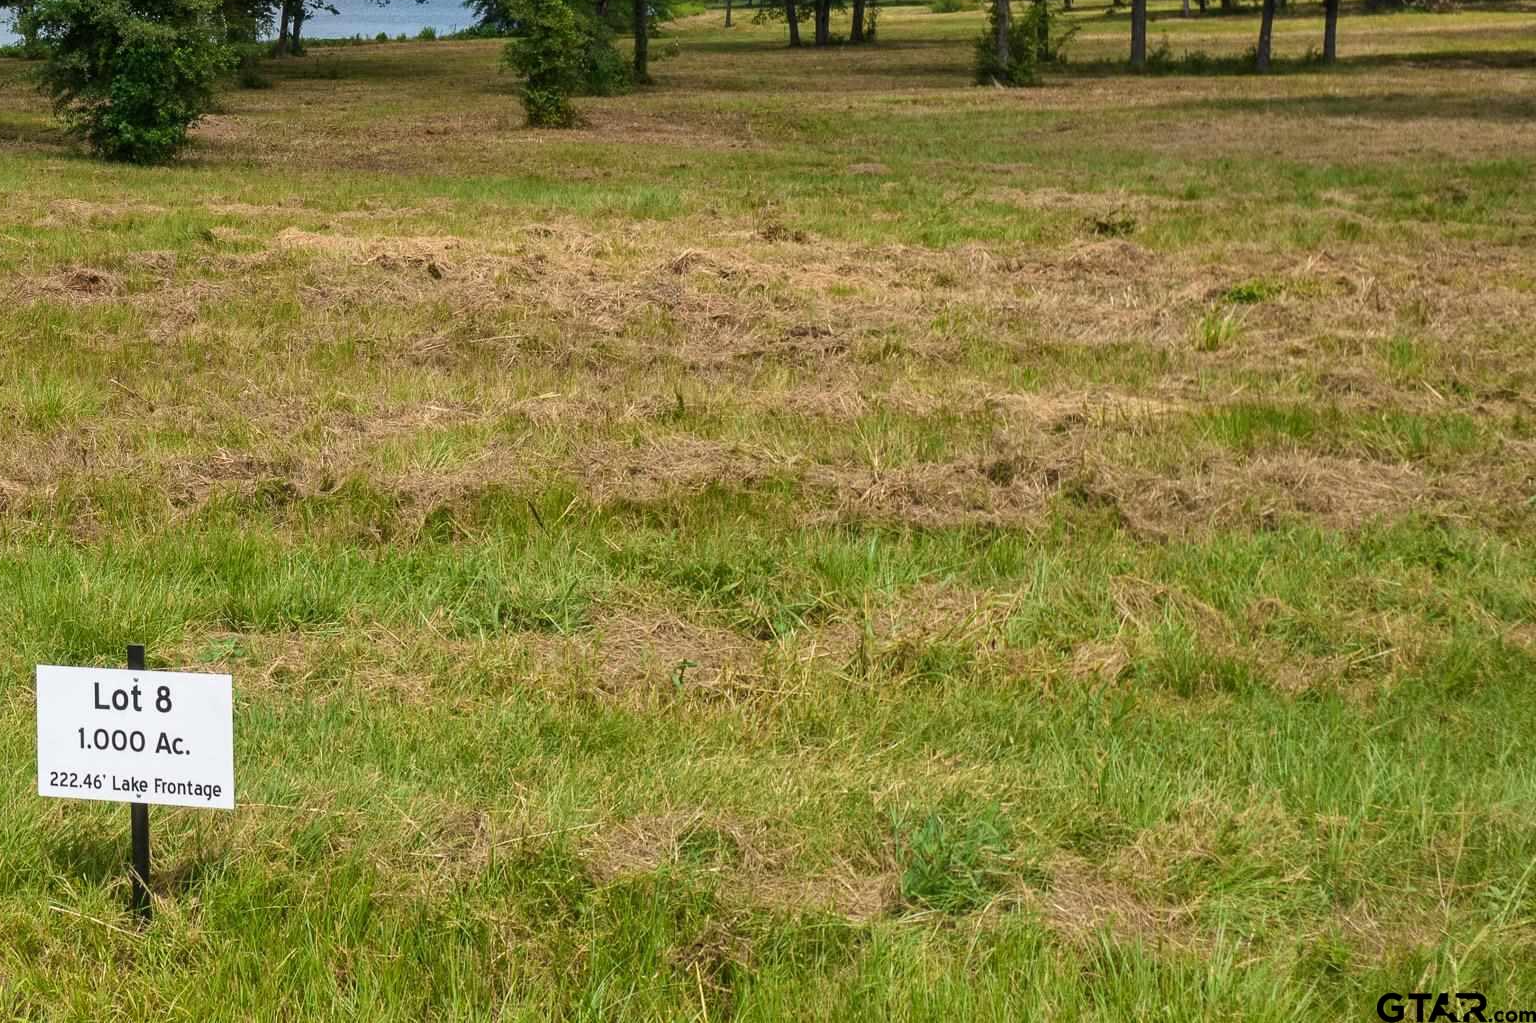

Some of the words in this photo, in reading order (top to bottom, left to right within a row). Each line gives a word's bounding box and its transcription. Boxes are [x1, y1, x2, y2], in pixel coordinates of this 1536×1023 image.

[94, 682, 142, 712] Lot
[155, 685, 173, 713] 8
[78, 727, 145, 752] 1.000
[155, 732, 190, 755] Ac.
[49, 771, 106, 790] 222.46'
[112, 775, 148, 793] Lake
[154, 778, 222, 801] Frontage
